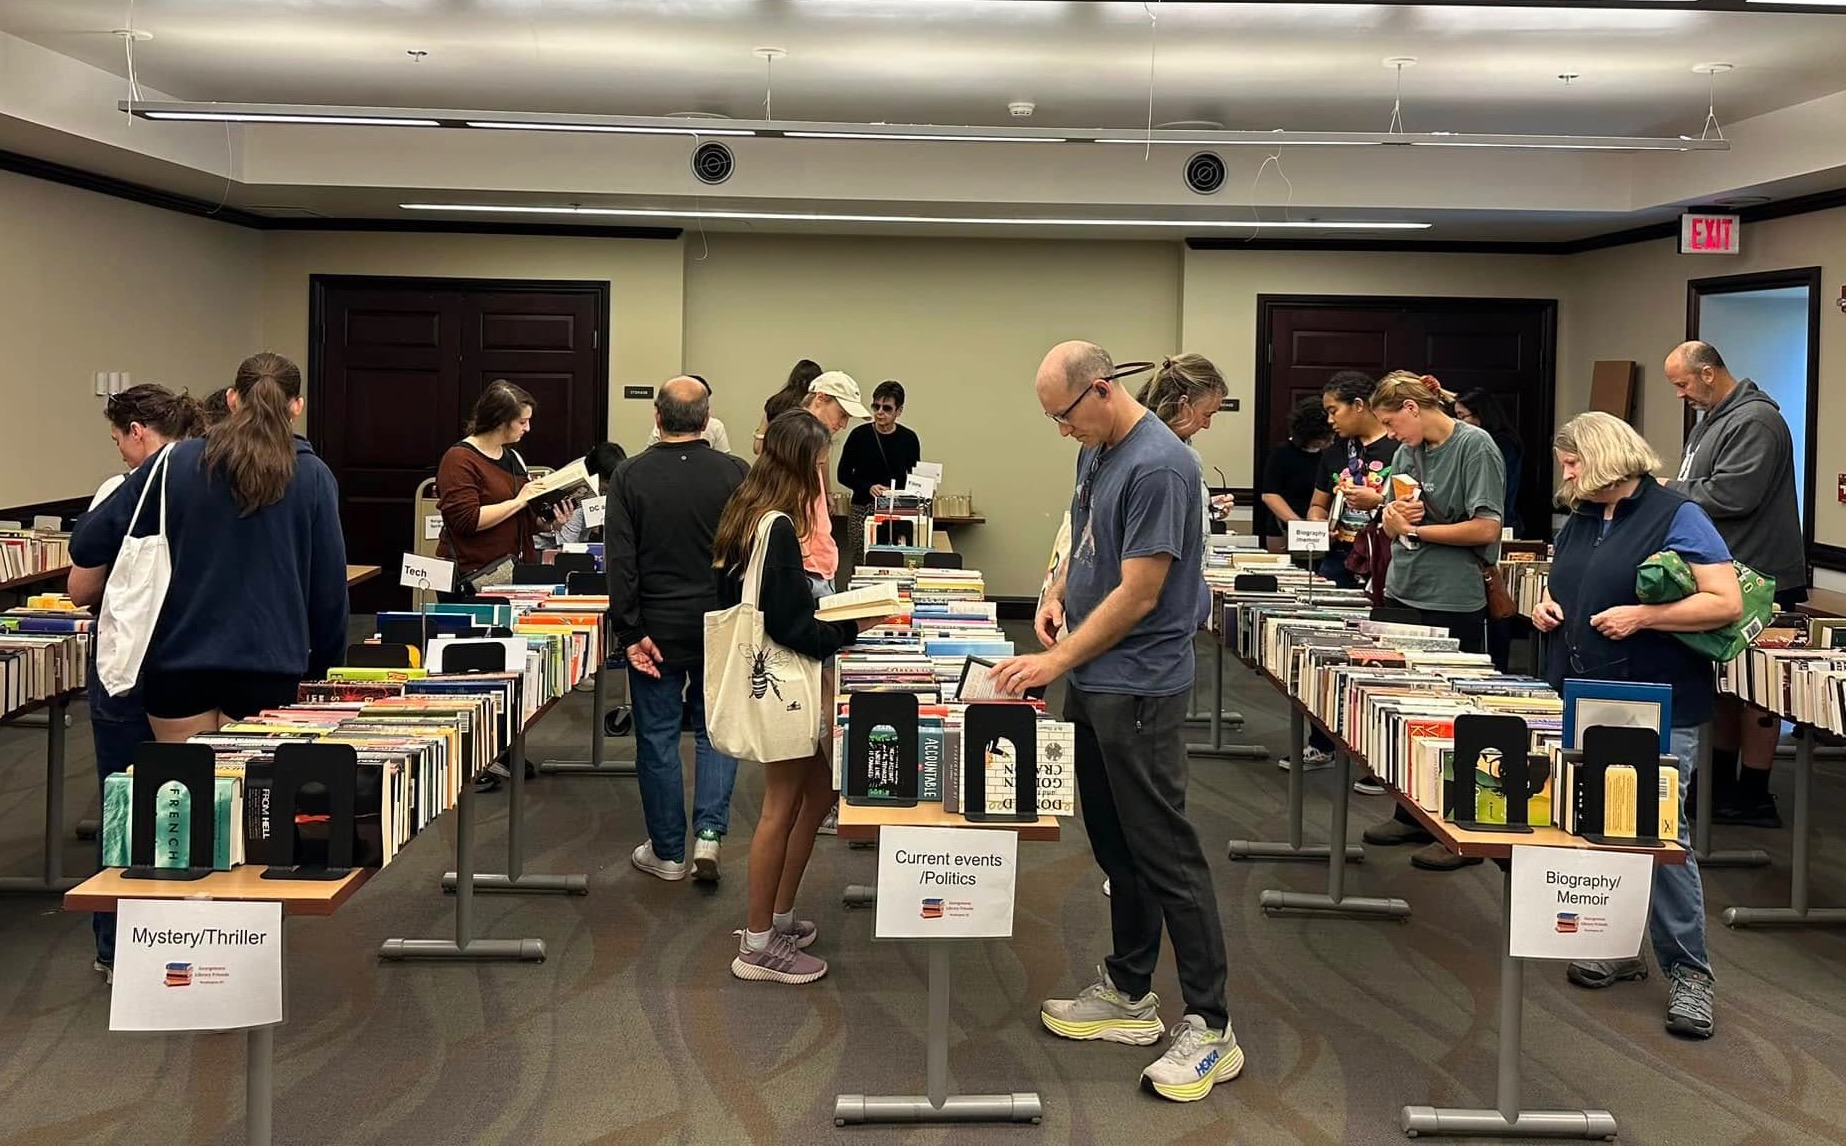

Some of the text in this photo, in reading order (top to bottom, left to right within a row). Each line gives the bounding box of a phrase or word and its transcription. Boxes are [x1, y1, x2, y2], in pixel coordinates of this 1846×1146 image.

[1691, 217, 1733, 250] EXIT
[589, 504, 600, 512] DC
[405, 565, 427, 578] Tech
[924, 738, 940, 798] ACCOUNTABLE
[168, 788, 180, 860] FRENCH
[262, 788, 270, 840] FROM HELL
[895, 850, 1002, 867] Current events
[919, 870, 977, 886] /Politics
[1546, 870, 1622, 890] Biography/
[1557, 890, 1610, 906] Memoir
[132, 928, 267, 948] Mystery/Thriller
[1195, 1050, 1219, 1077] HOKA
